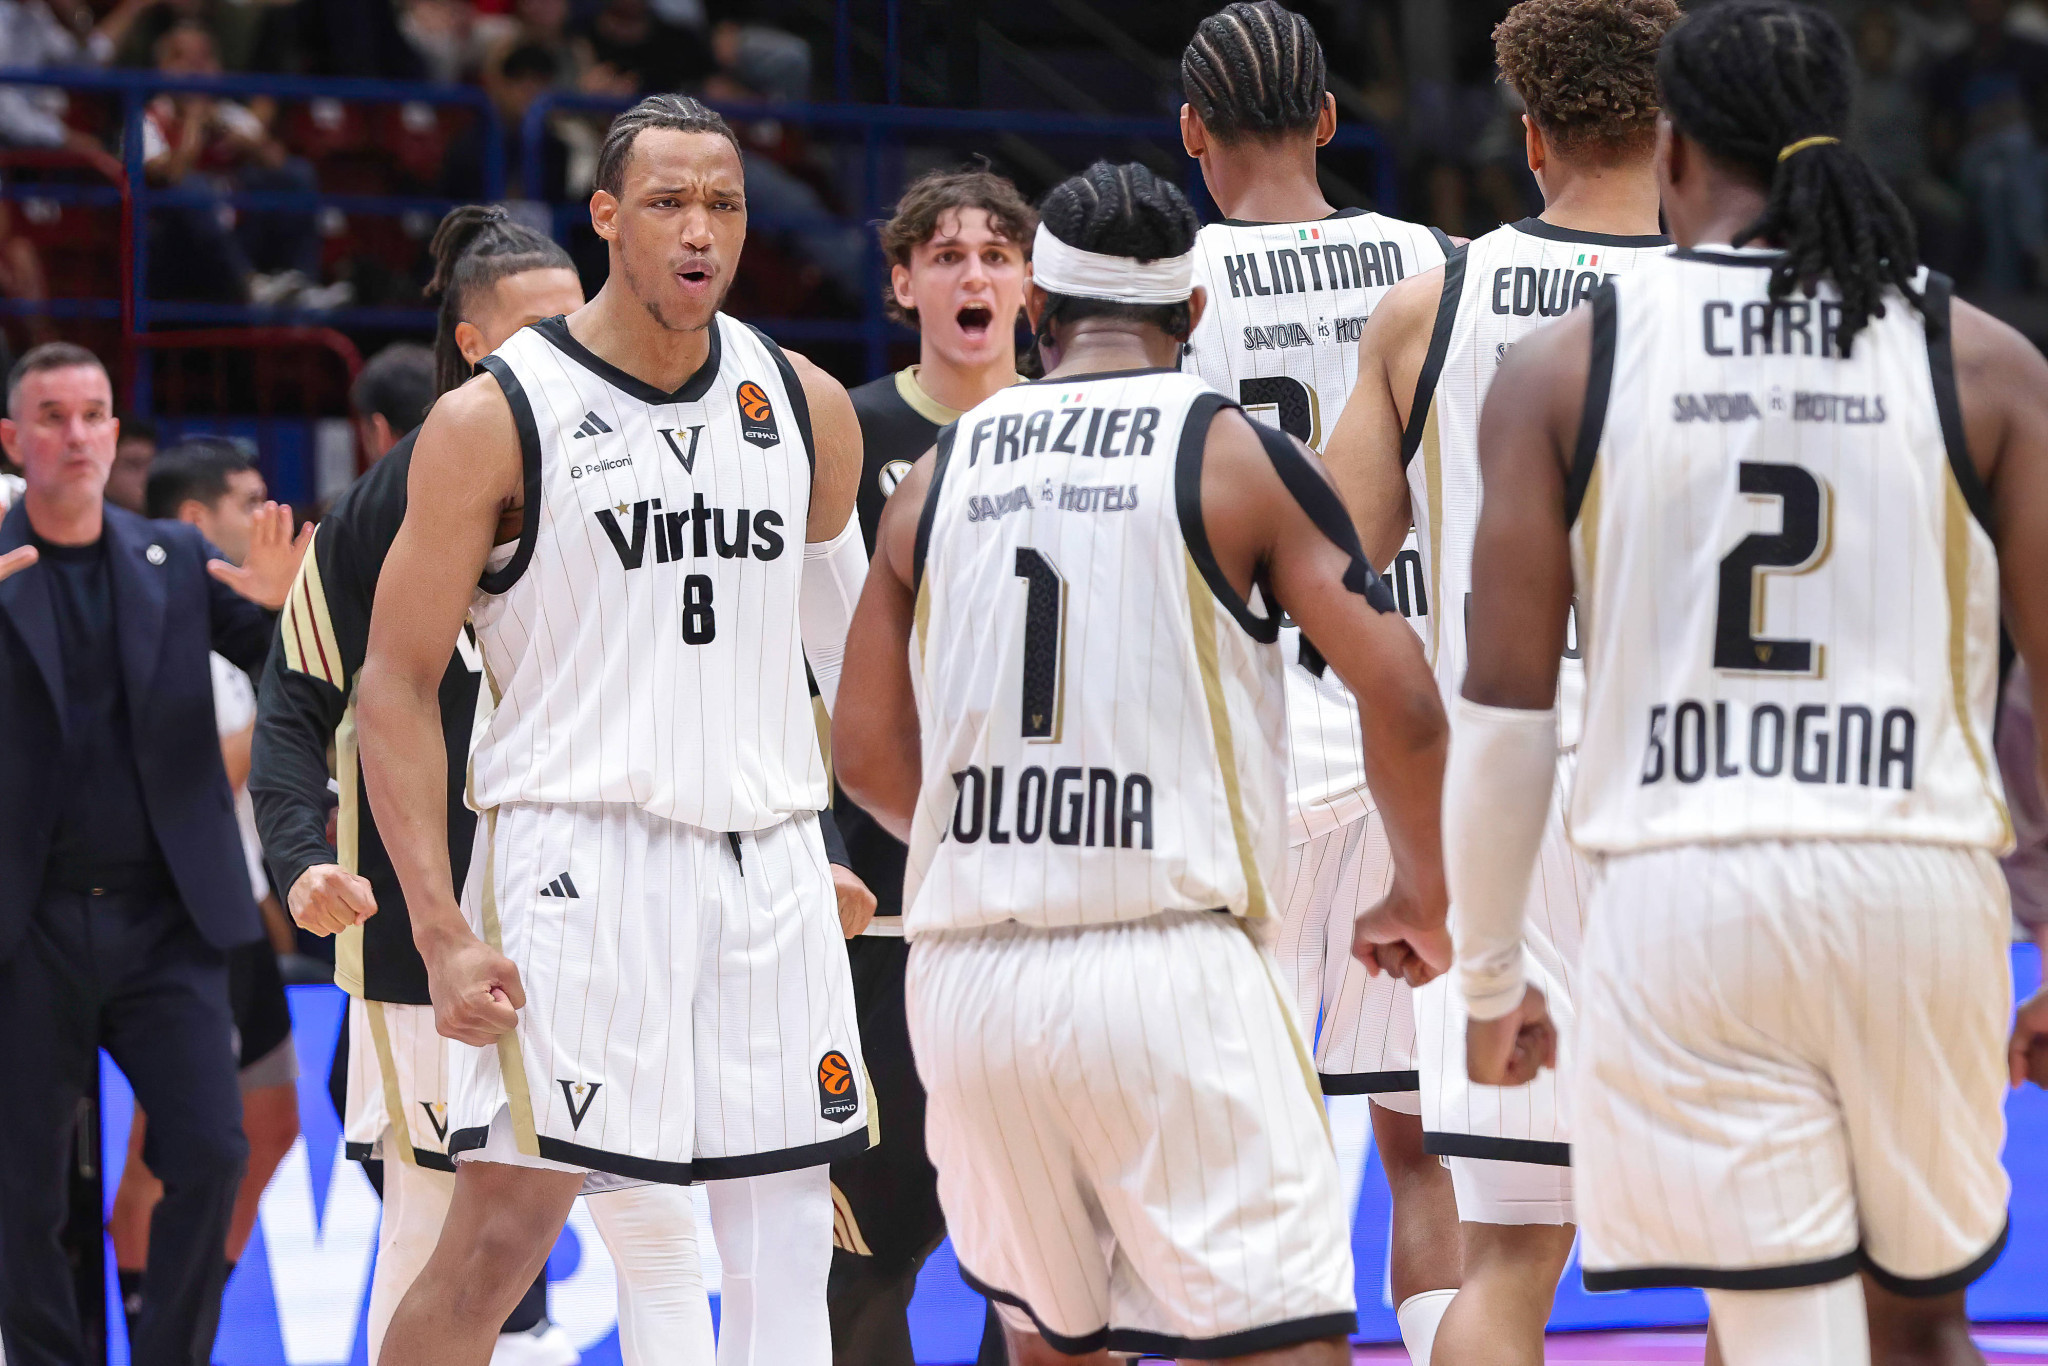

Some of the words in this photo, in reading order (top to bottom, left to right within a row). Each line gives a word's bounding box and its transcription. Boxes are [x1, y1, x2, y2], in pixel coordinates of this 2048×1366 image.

[1224, 241, 1405, 298] KLINTMAN
[1492, 266, 1621, 317] EDWA
[1243, 322, 1314, 350] SAVOIA
[585, 453, 633, 475] Pelliconi
[745, 431, 778, 440] ETIHAD
[968, 406, 1161, 469] FRAZIER
[1058, 483, 1139, 513] HOTELS
[594, 492, 785, 571] Virtus
[1714, 461, 1833, 678] 2
[682, 574, 716, 645] 8
[1015, 546, 1069, 744] 1
[941, 764, 1154, 850] OLOGNA
[823, 1103, 857, 1115] ETIHAD
